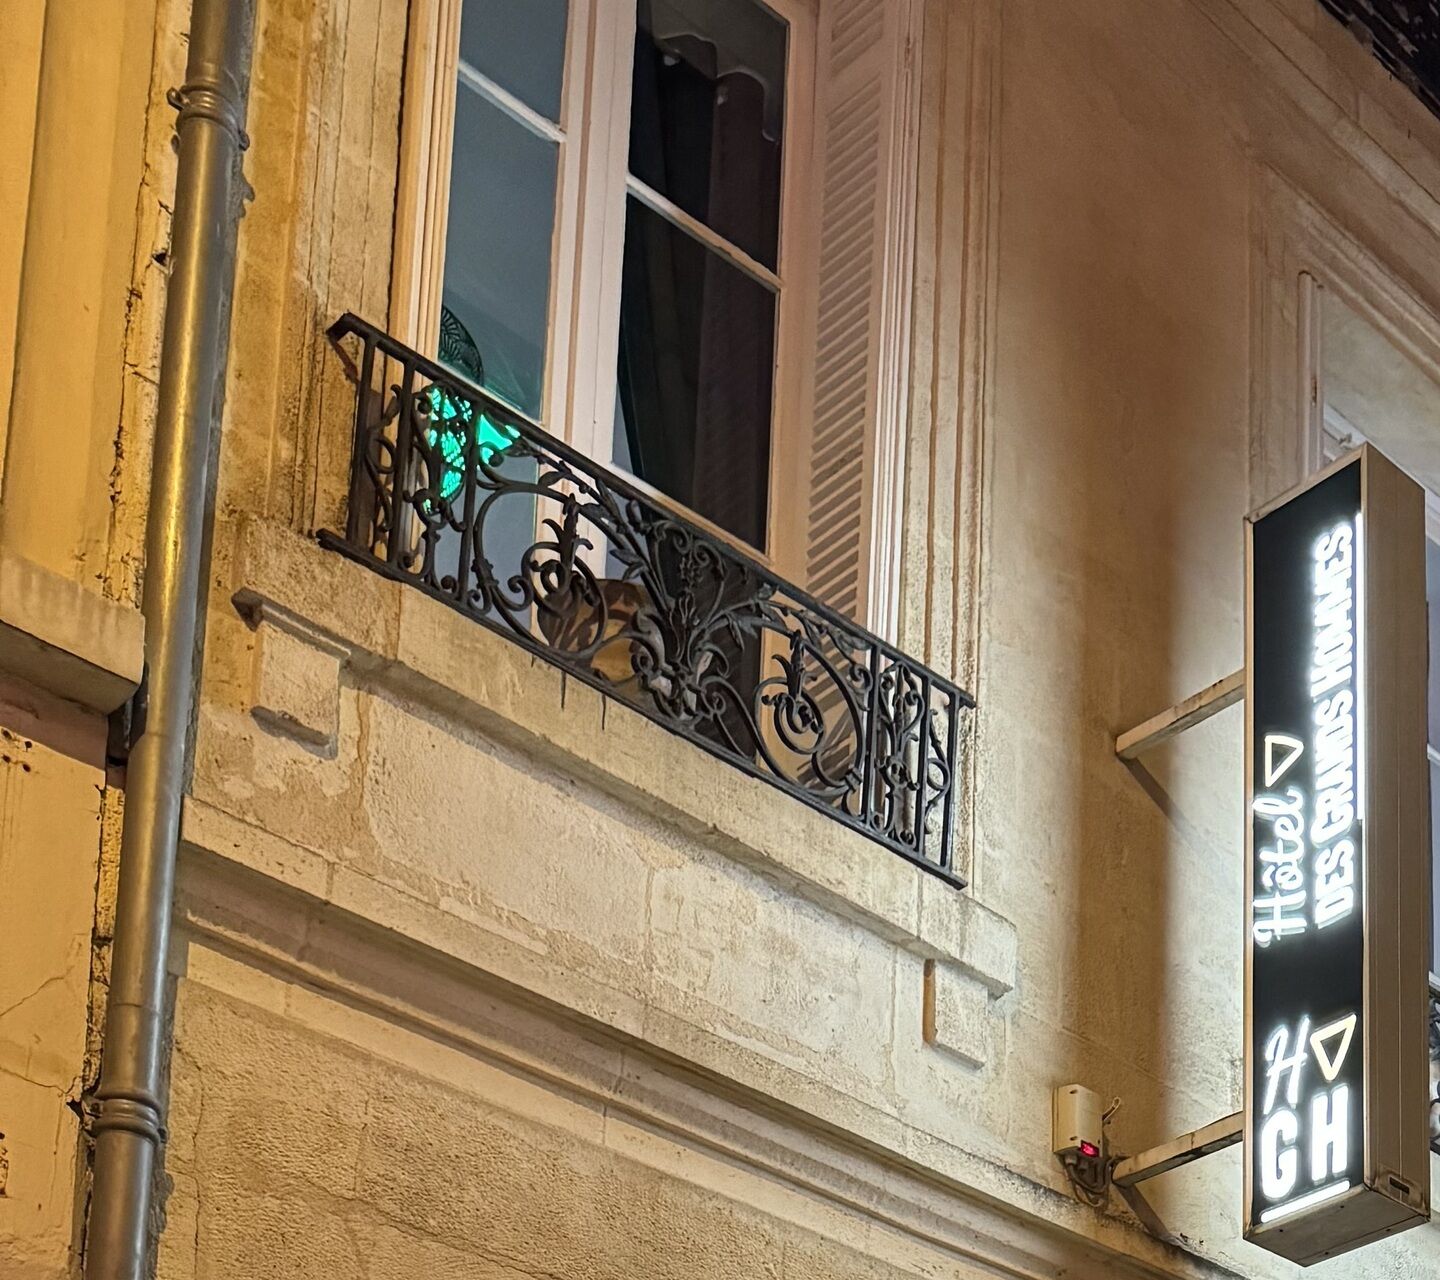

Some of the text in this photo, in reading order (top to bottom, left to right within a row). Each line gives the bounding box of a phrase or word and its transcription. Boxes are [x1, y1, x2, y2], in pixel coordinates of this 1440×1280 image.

[1310, 523, 1354, 929] DES GRANDS HOMMES
[1252, 786, 1307, 943] Hôtel
[1264, 1016, 1309, 1114] H
[1261, 1084, 1349, 1198] GH
